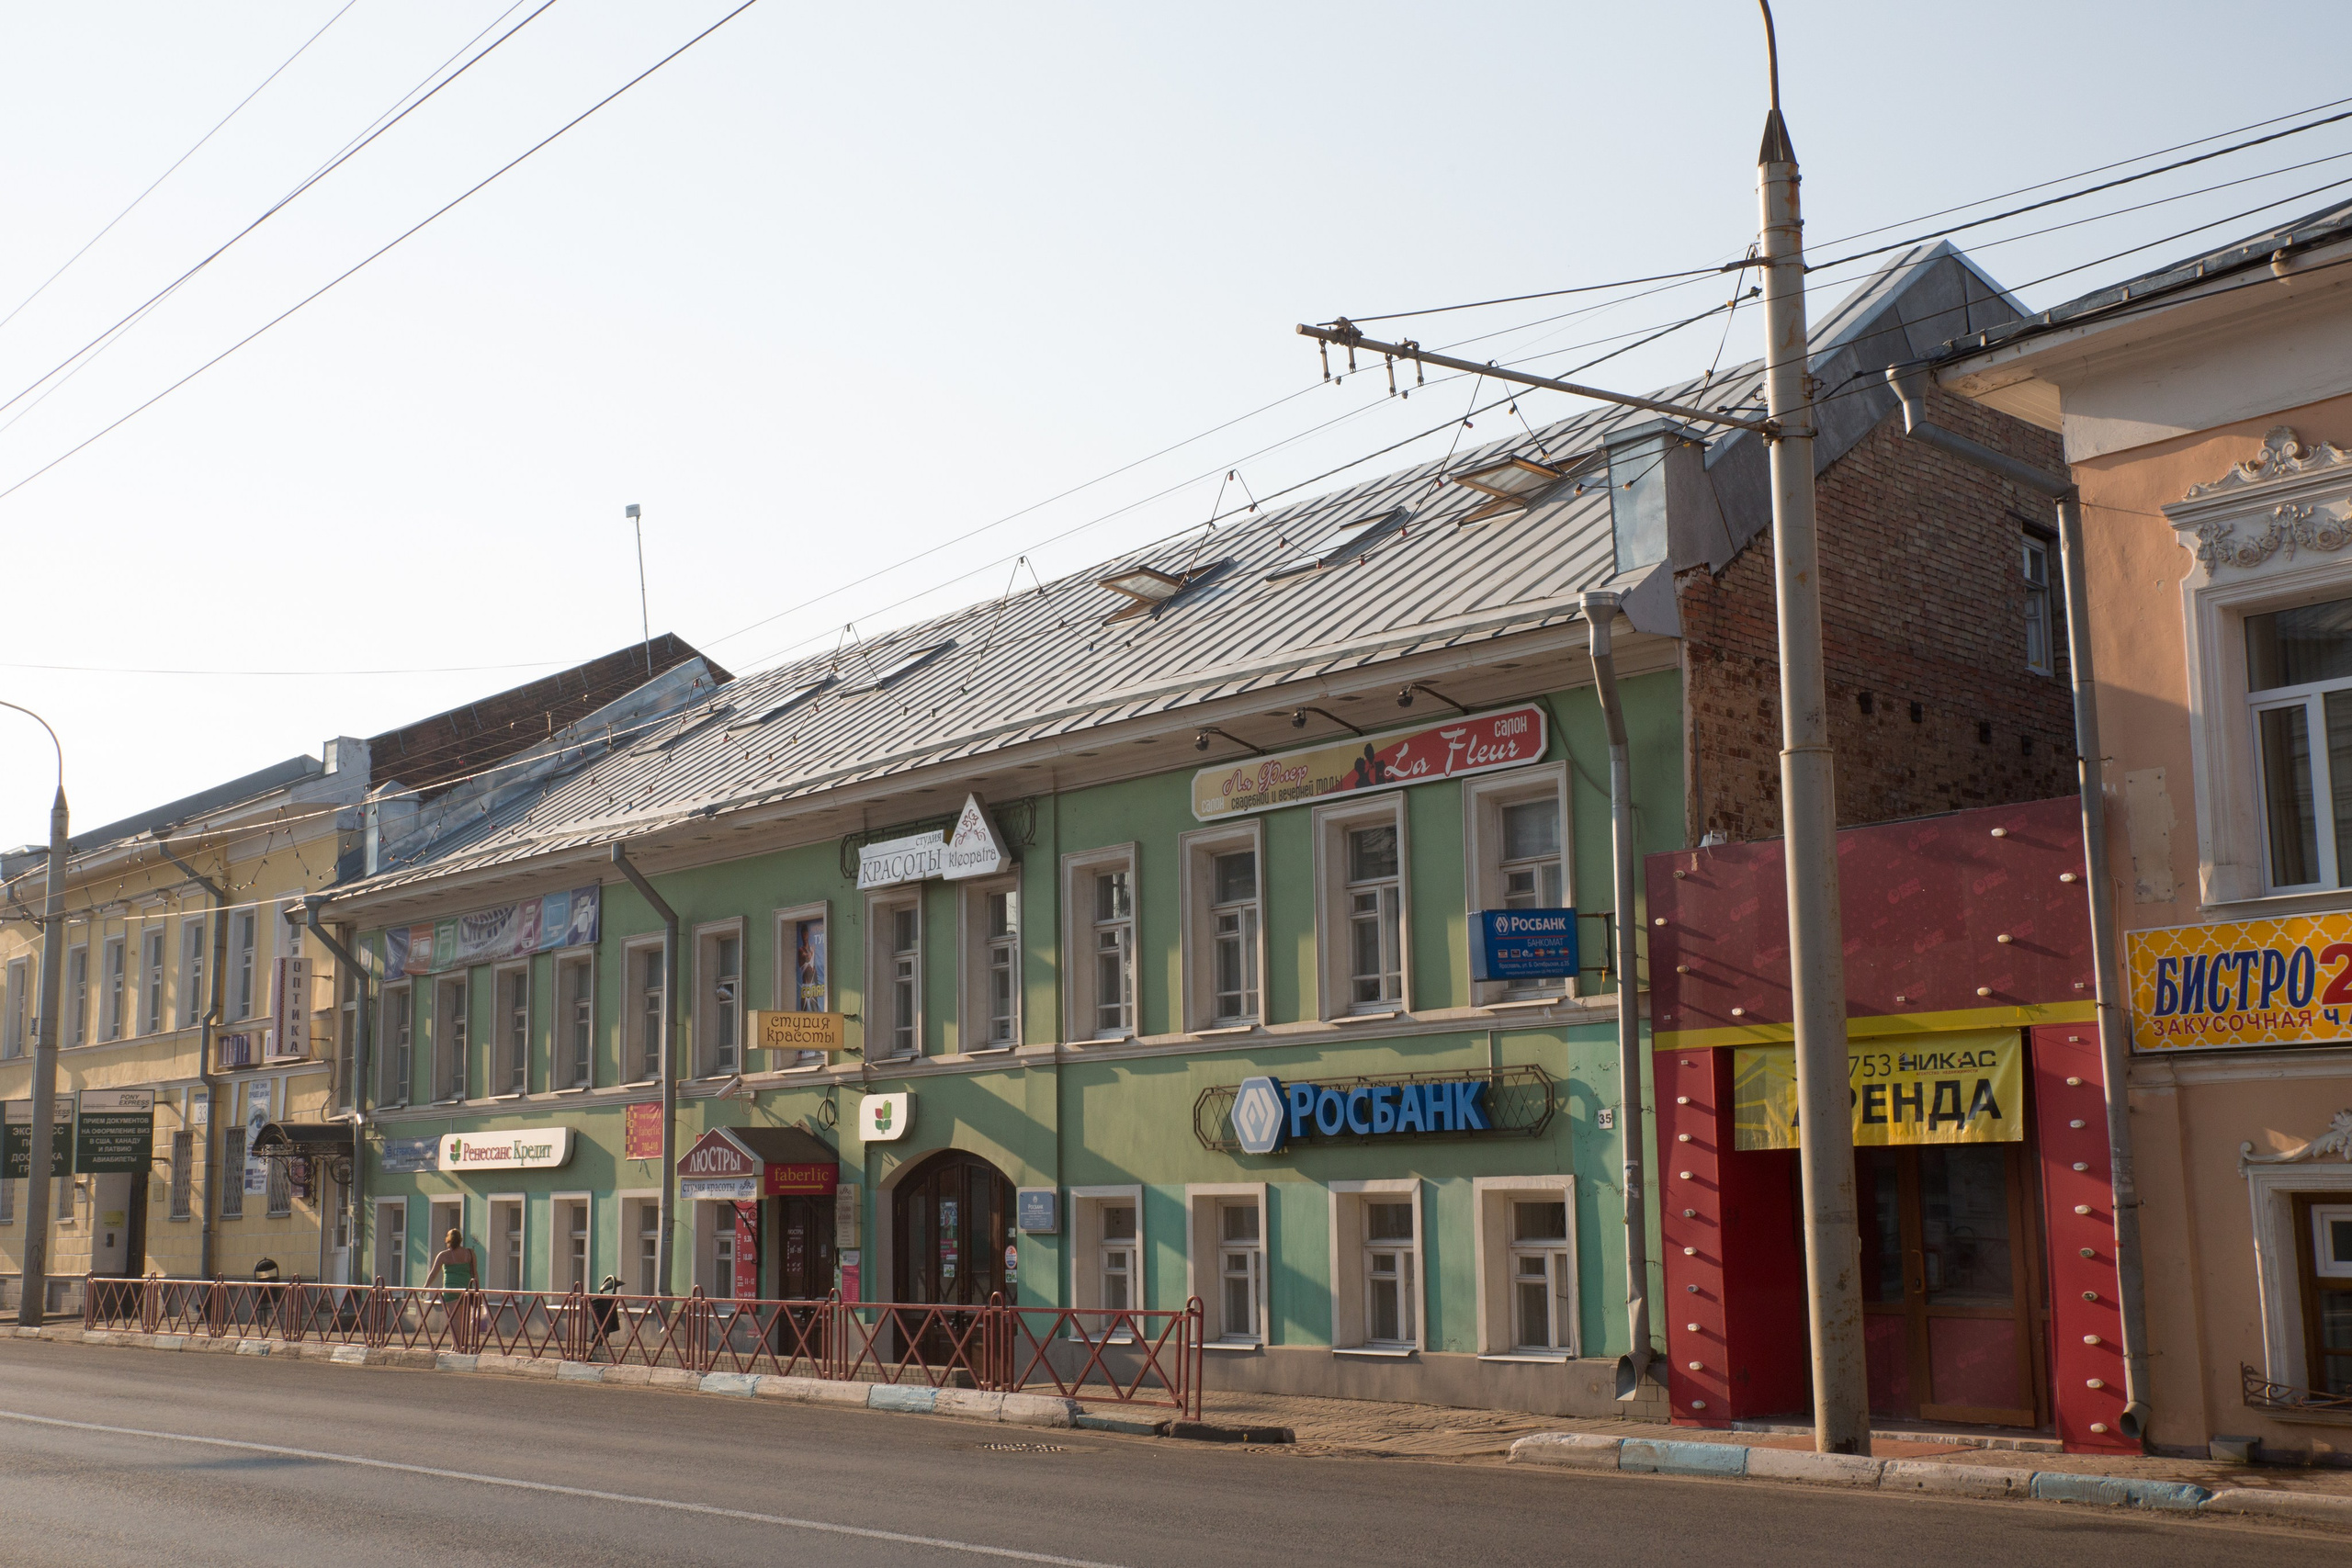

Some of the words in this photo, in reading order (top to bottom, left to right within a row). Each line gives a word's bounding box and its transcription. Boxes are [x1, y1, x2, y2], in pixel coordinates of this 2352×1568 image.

[1494, 715, 1528, 738] салон
[1384, 742, 1430, 779] La
[1440, 728, 1521, 778] Fleur
[1222, 769, 1253, 796] Ля
[1258, 760, 1308, 794] Флер
[1201, 797, 1225, 814] салон
[1231, 789, 1269, 811] свадебной
[1271, 792, 1276, 803] и
[1278, 781, 1314, 802] вечерней
[1316, 774, 1343, 795] моды
[915, 831, 943, 850] студия
[862, 849, 943, 884] КРАСОТЫ
[948, 847, 997, 868] kleopatra
[1510, 917, 1566, 931] РОСБАНК
[1527, 938, 1564, 947] БАНКОМАТ
[2154, 945, 2316, 1017] БИСТРО
[289, 961, 301, 1053] ОПТИКА
[771, 1015, 831, 1032] студия
[2153, 1010, 2313, 1037] ЗАКУСОЧНАЯ
[2323, 1009, 2352, 1025] Ч
[766, 1027, 835, 1045] красоты
[198, 1106, 207, 1122] 33
[1290, 1081, 1492, 1137] РОСБАНК
[1598, 1113, 1612, 1124] 35
[12, 1127, 64, 1135] ЭКССС
[106, 1117, 150, 1125] ДОКУМЕНТОВ
[11, 1153, 63, 1163] ДОСКА
[463, 1143, 512, 1162] Ренессанс
[513, 1140, 552, 1166] Кредит
[690, 1146, 741, 1172] ЛЮСТРЫ
[774, 1168, 829, 1181] faberlic
[682, 1180, 706, 1193] студия
[707, 1182, 735, 1196] красоты
